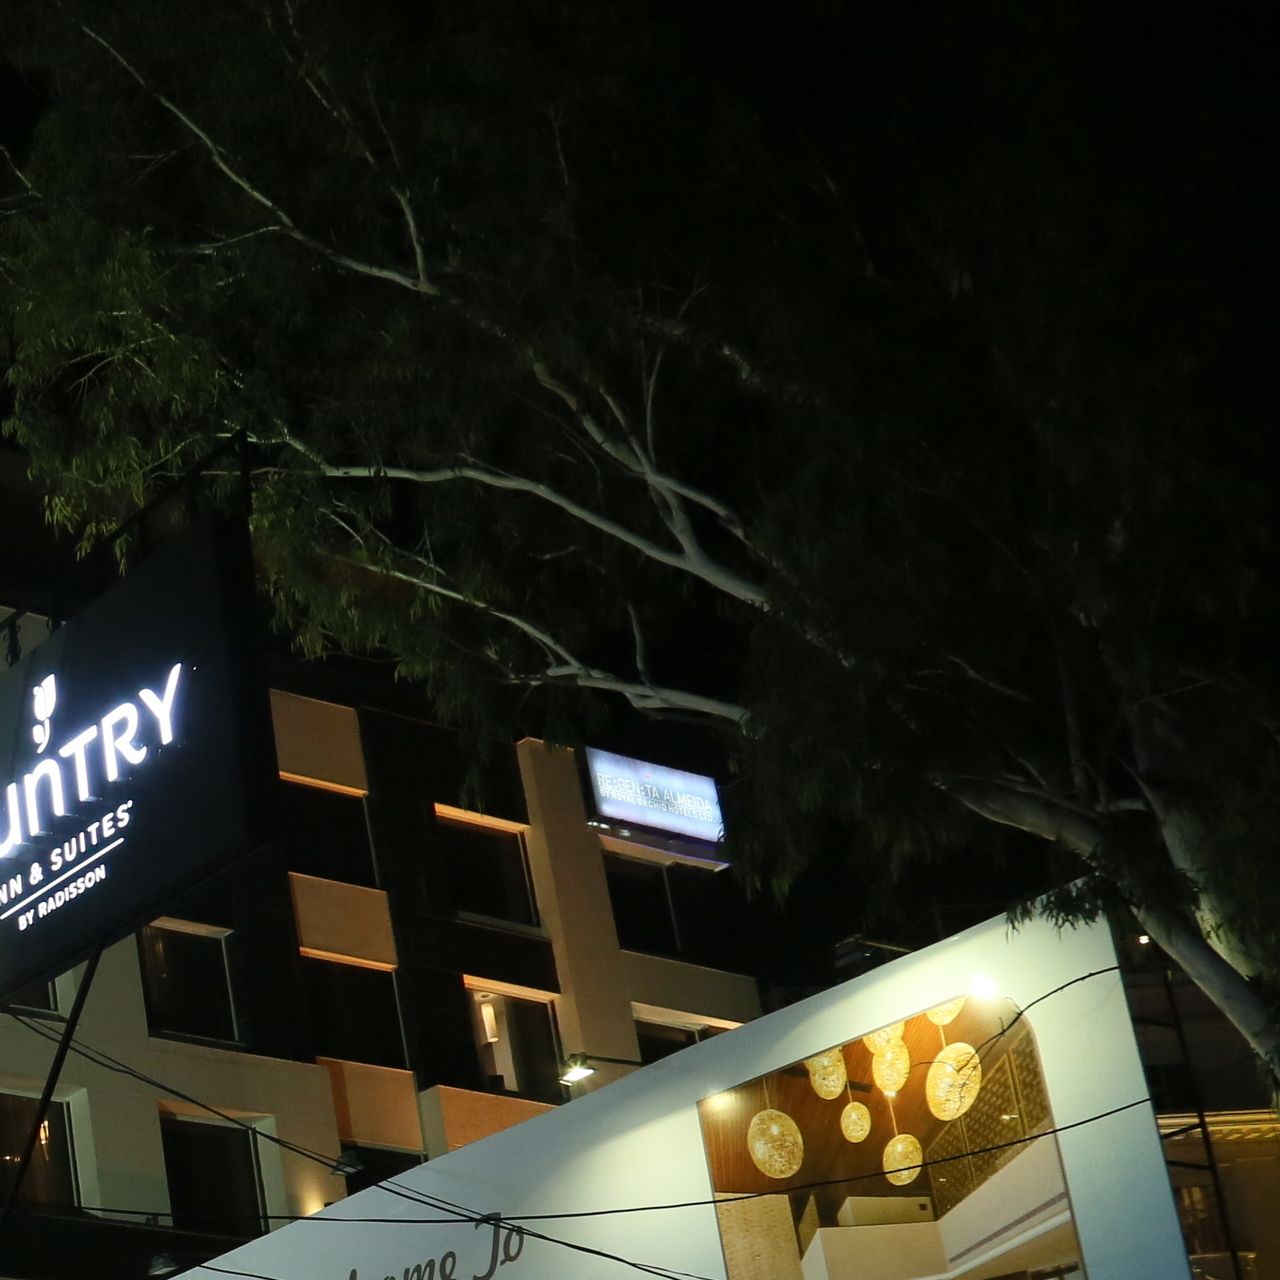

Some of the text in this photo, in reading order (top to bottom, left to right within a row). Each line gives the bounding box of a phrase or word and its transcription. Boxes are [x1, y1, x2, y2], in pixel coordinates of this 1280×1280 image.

[663, 790, 713, 812] ALMEIDA
[29, 862, 43, 885] &
[50, 804, 130, 871] SUITES
[18, 864, 106, 931] BY RADISSON
